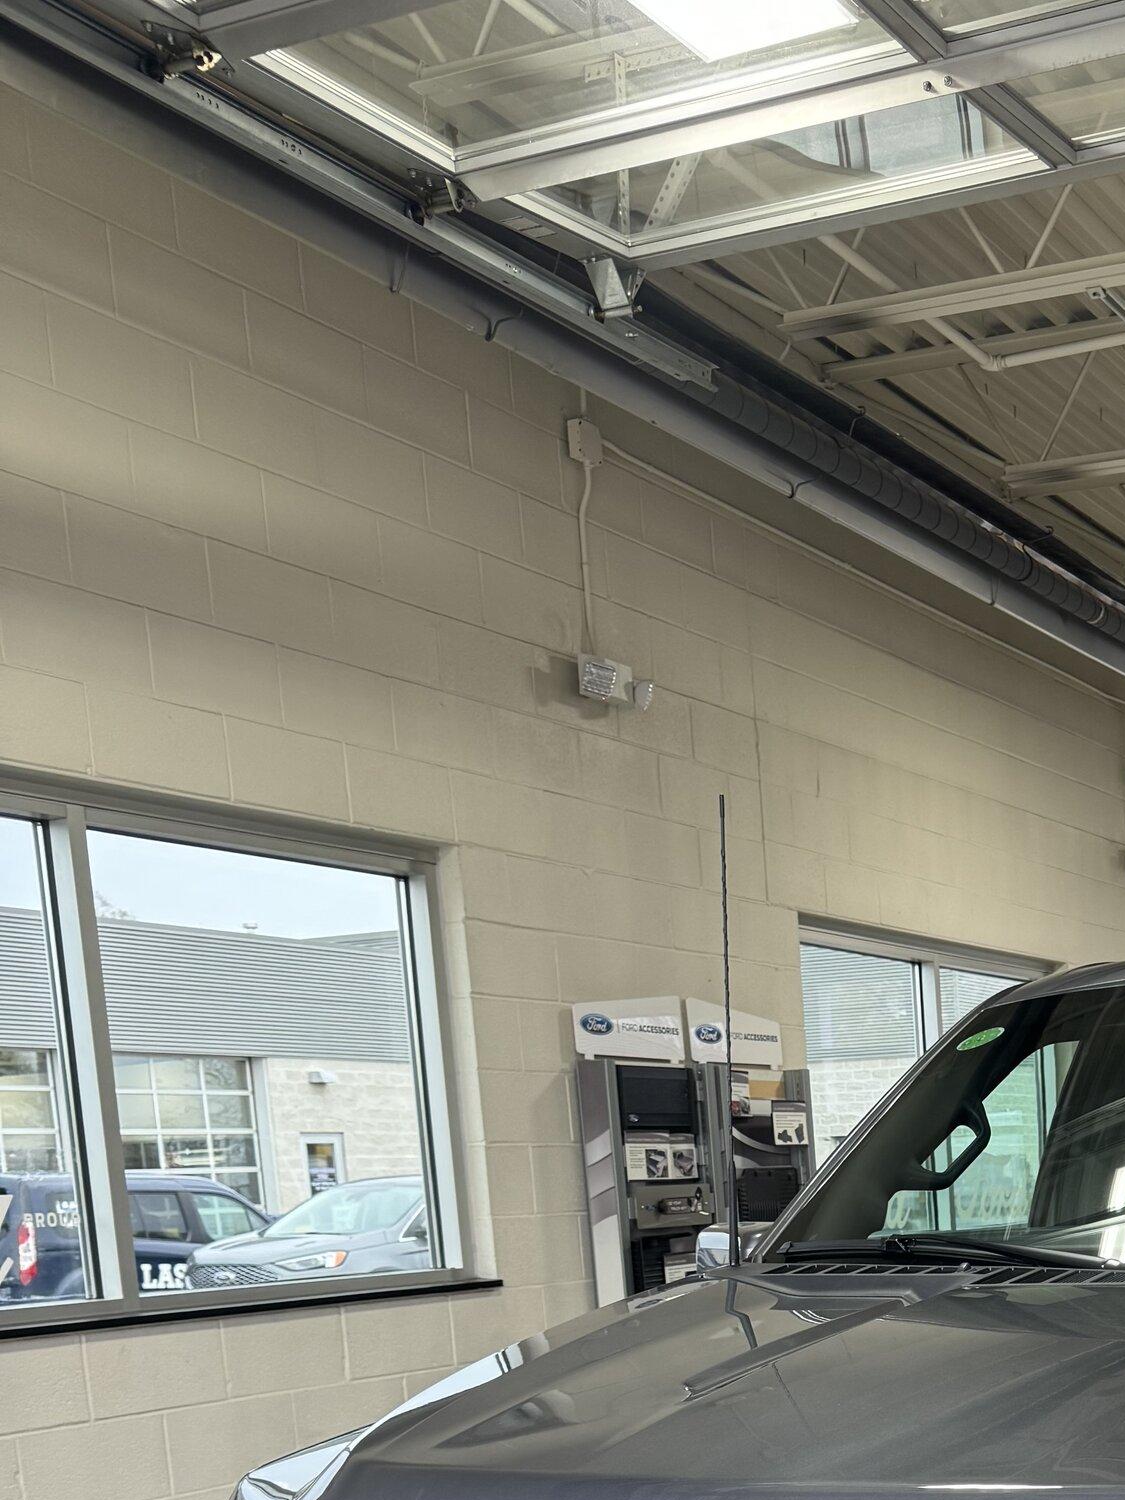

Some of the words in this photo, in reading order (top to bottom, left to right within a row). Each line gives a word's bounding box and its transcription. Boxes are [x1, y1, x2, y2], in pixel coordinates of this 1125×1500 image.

[587, 1016, 608, 1033] Ford
[621, 1022, 638, 1033] FORD
[638, 1024, 680, 1036] ACCESSORIES
[700, 1026, 718, 1041] Ford
[743, 1032, 779, 1043] ACCESSORIES
